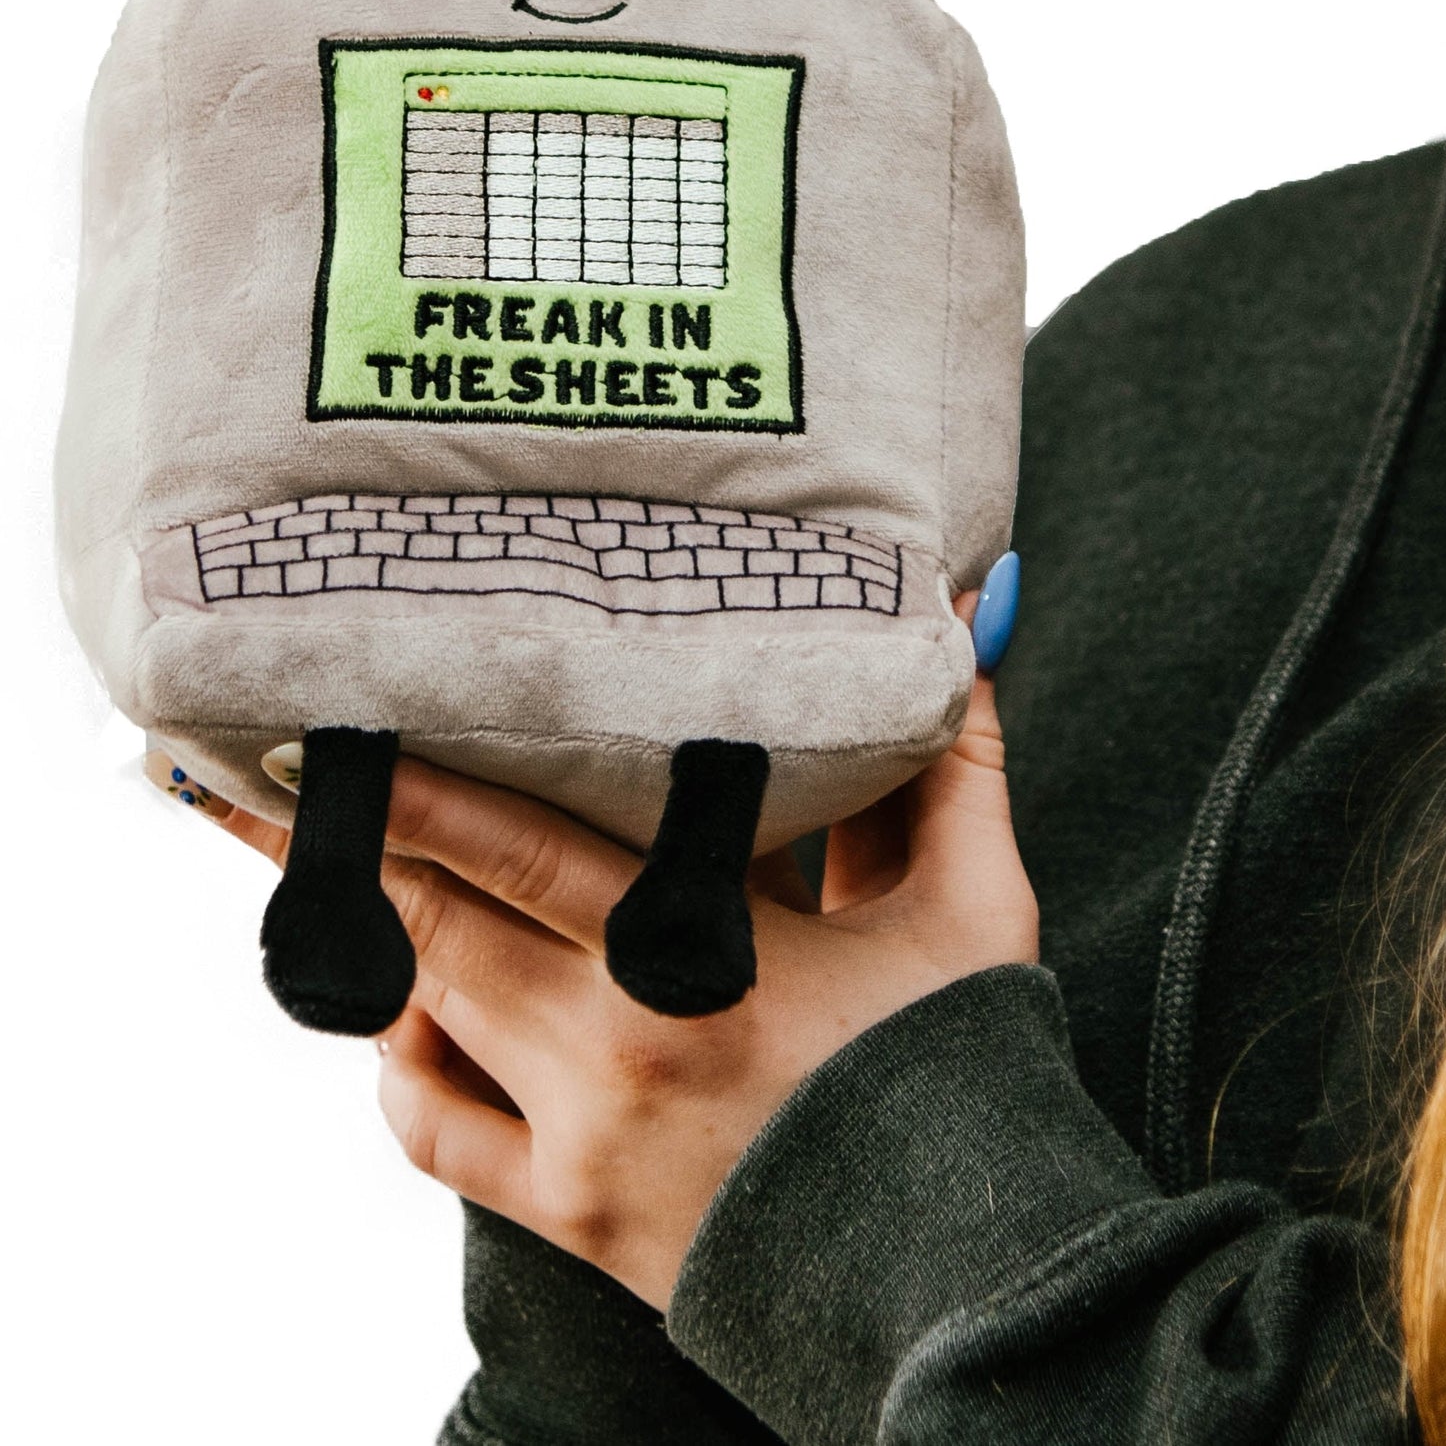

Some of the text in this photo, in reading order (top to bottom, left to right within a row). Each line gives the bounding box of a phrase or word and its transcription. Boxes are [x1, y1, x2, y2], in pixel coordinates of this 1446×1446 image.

[414, 292, 711, 350] FREAK IN
[366, 353, 762, 409] THE SHEETS
